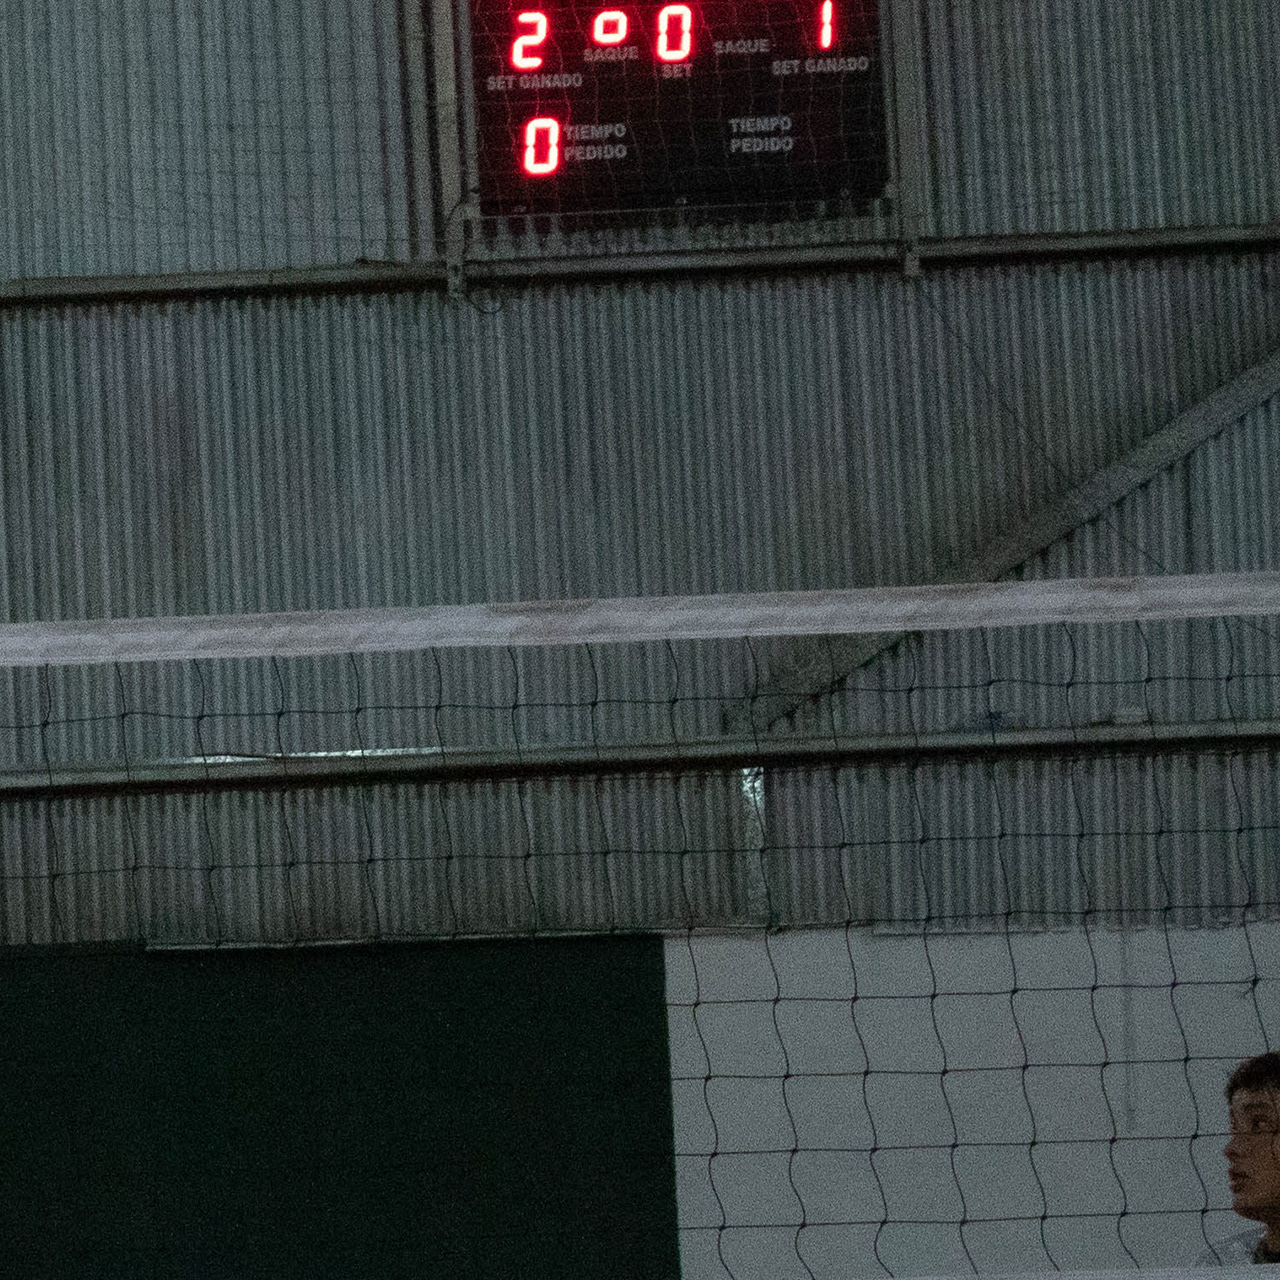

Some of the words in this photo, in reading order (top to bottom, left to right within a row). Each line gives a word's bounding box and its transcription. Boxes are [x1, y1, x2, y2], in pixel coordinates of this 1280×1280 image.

[511, 11, 548, 70] 2
[715, 39, 771, 55] SAQUE
[583, 46, 640, 62] SAQUE
[661, 63, 692, 79] SET
[772, 60, 800, 76] SET
[805, 57, 870, 74] GANADO
[486, 75, 516, 91] SET
[519, 72, 583, 90] GANADO
[564, 124, 627, 141] TIEMPO
[729, 117, 792, 134] TIEMPO
[564, 145, 627, 162] PEDIDO
[730, 137, 794, 153] PEDIDO
